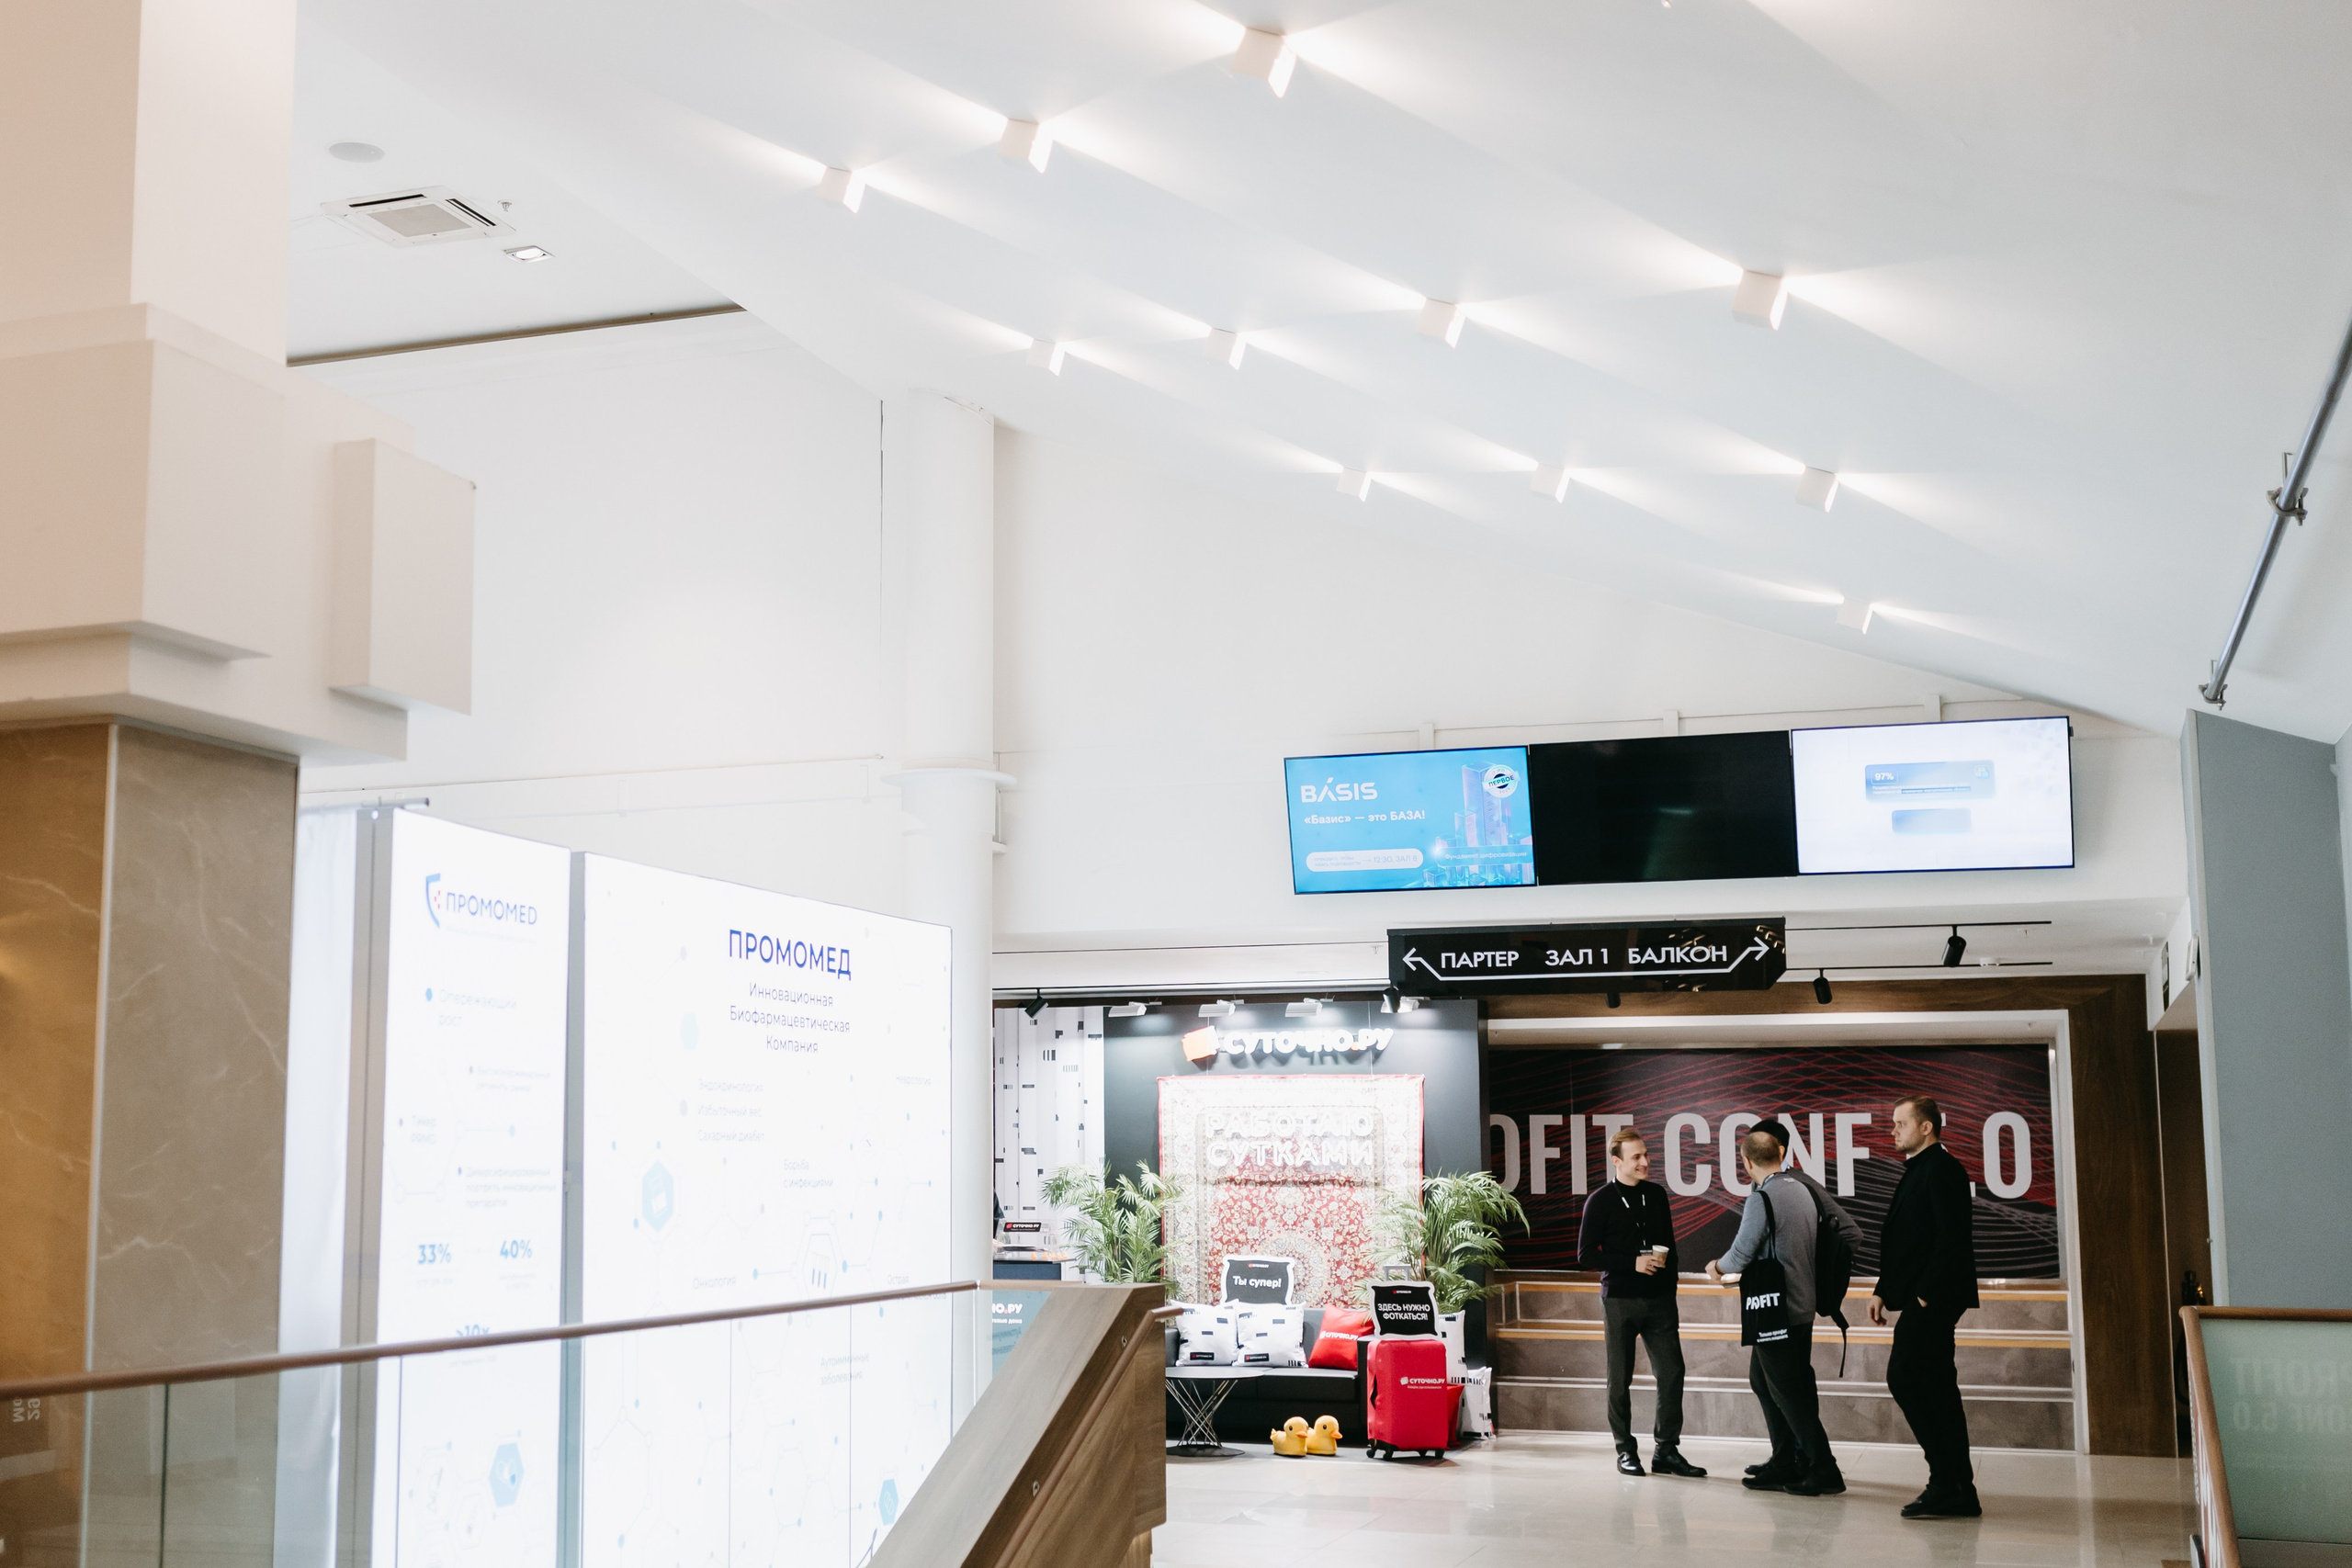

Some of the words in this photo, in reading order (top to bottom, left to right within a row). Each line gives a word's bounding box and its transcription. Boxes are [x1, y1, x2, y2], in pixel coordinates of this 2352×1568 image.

[1488, 774, 1515, 787] ПЕРВОЕ
[1874, 773, 1894, 781] 97%
[1304, 814, 1351, 825] «Базис»
[1368, 814, 1387, 822] это
[1390, 810, 1426, 821] БАЗА!
[729, 929, 851, 981] ПРОМОМЕД
[1441, 951, 1520, 969] ПАРТЕР
[1545, 949, 1593, 966] ЗАЛ
[1600, 948, 1609, 964] 1
[1628, 945, 1727, 964] БАЛКОН
[749, 982, 833, 1007] Инновационная
[729, 1005, 851, 1032] Биофармацевтическая
[766, 1035, 819, 1054] Компания
[1223, 1028, 1394, 1055] СУТОЧНО.РУ
[1206, 1141, 1374, 1166] СУТКАМИ
[1664, 1112, 1872, 1197] CONF
[784, 1157, 809, 1172] Борьба
[417, 1243, 452, 1265] 33%
[500, 1239, 533, 1259] 40%
[693, 1276, 736, 1290] Онкология
[888, 1273, 910, 1285] Острая
[1232, 1275, 1248, 1286] Ты
[1249, 1278, 1283, 1290] супер!
[1378, 1303, 1402, 1312] ЗДЕСЬ
[1402, 1303, 1430, 1312] НУЖНО
[1383, 1312, 1428, 1321] ФОТКАТЬСЯ!
